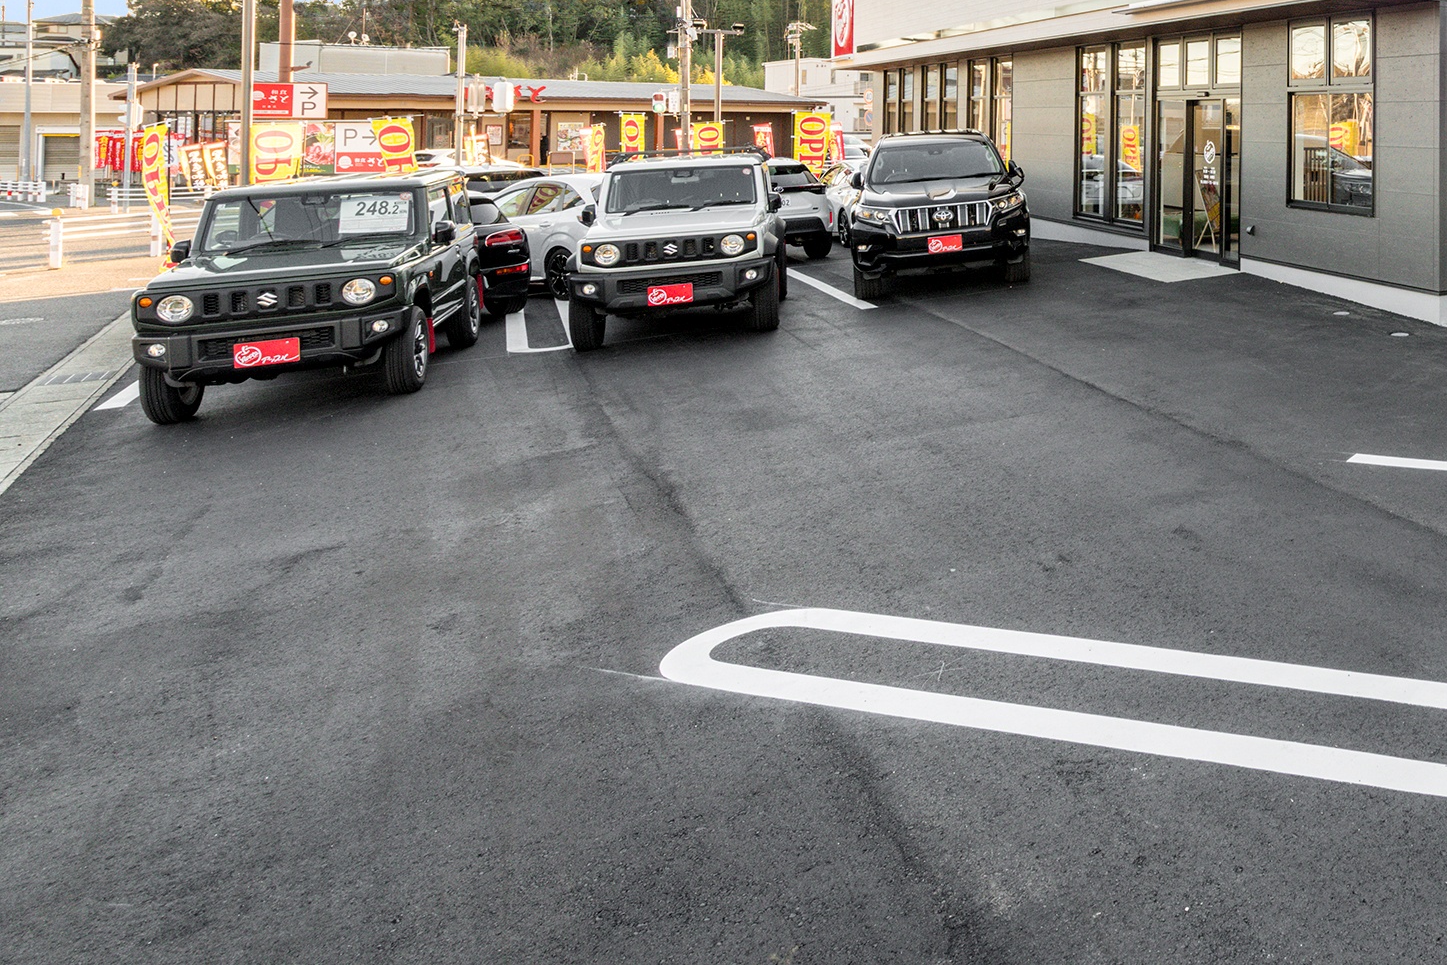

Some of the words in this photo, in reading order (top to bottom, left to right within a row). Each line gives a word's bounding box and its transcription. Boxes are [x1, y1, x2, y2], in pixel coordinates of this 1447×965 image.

[302, 101, 317, 116] P
[344, 128, 358, 146] P
[800, 116, 825, 179] OPE
[355, 200, 399, 216] 248.2
